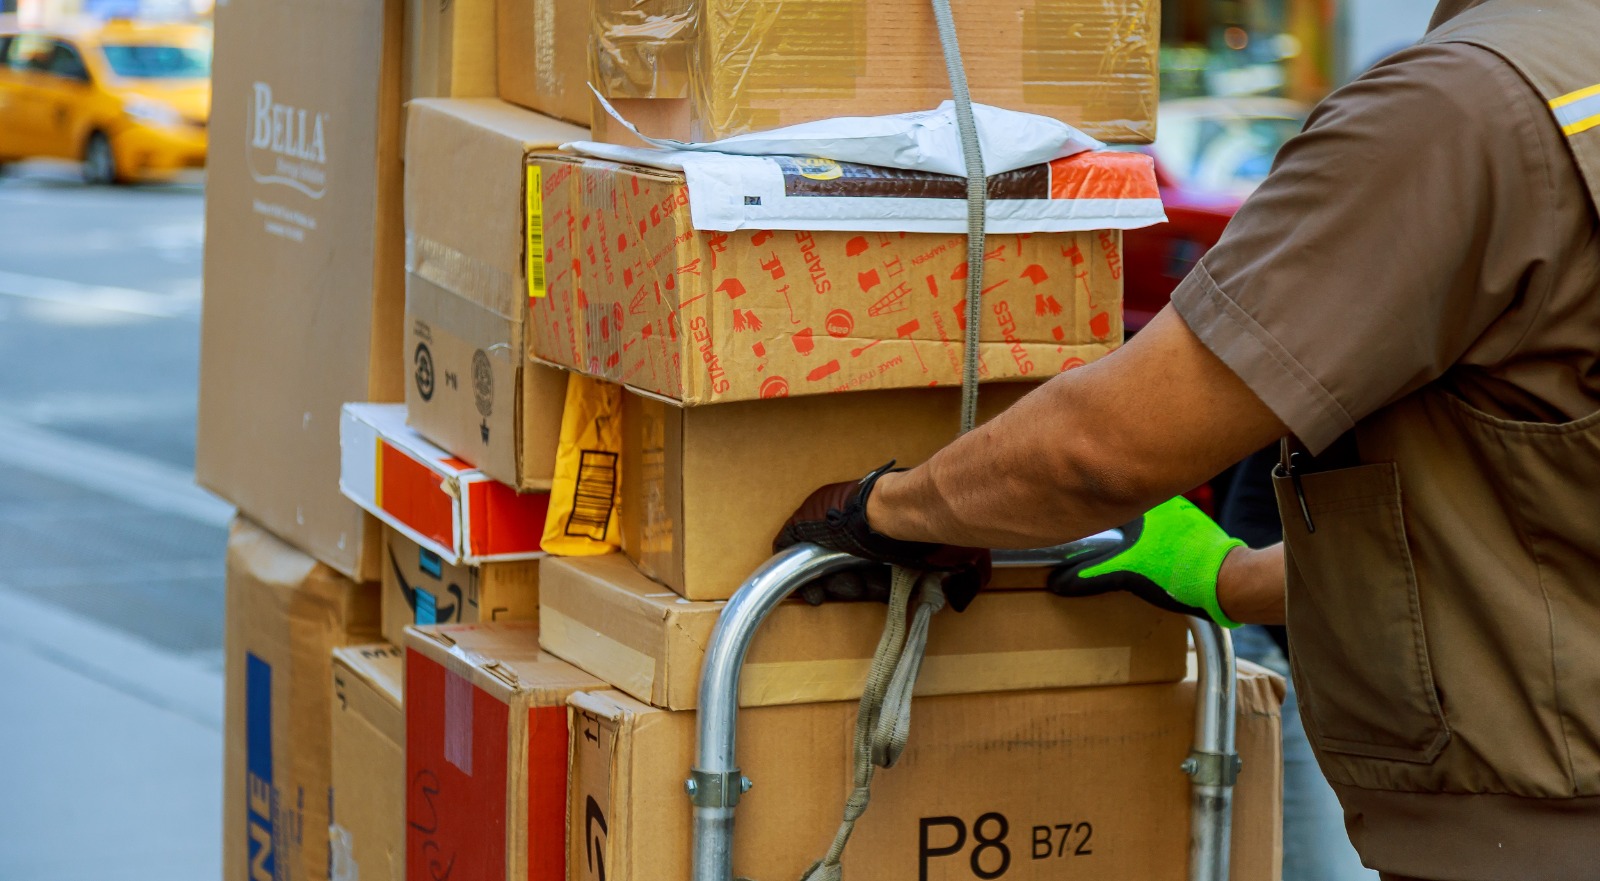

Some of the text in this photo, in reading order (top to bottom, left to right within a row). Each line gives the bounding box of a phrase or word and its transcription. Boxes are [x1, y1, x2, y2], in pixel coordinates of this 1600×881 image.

[252, 81, 326, 163] BELLA
[689, 315, 730, 395] STAPLES
[877, 355, 903, 374] MAKE
[993, 300, 1034, 376] STAPLES
[918, 812, 1093, 881] P8 B72
